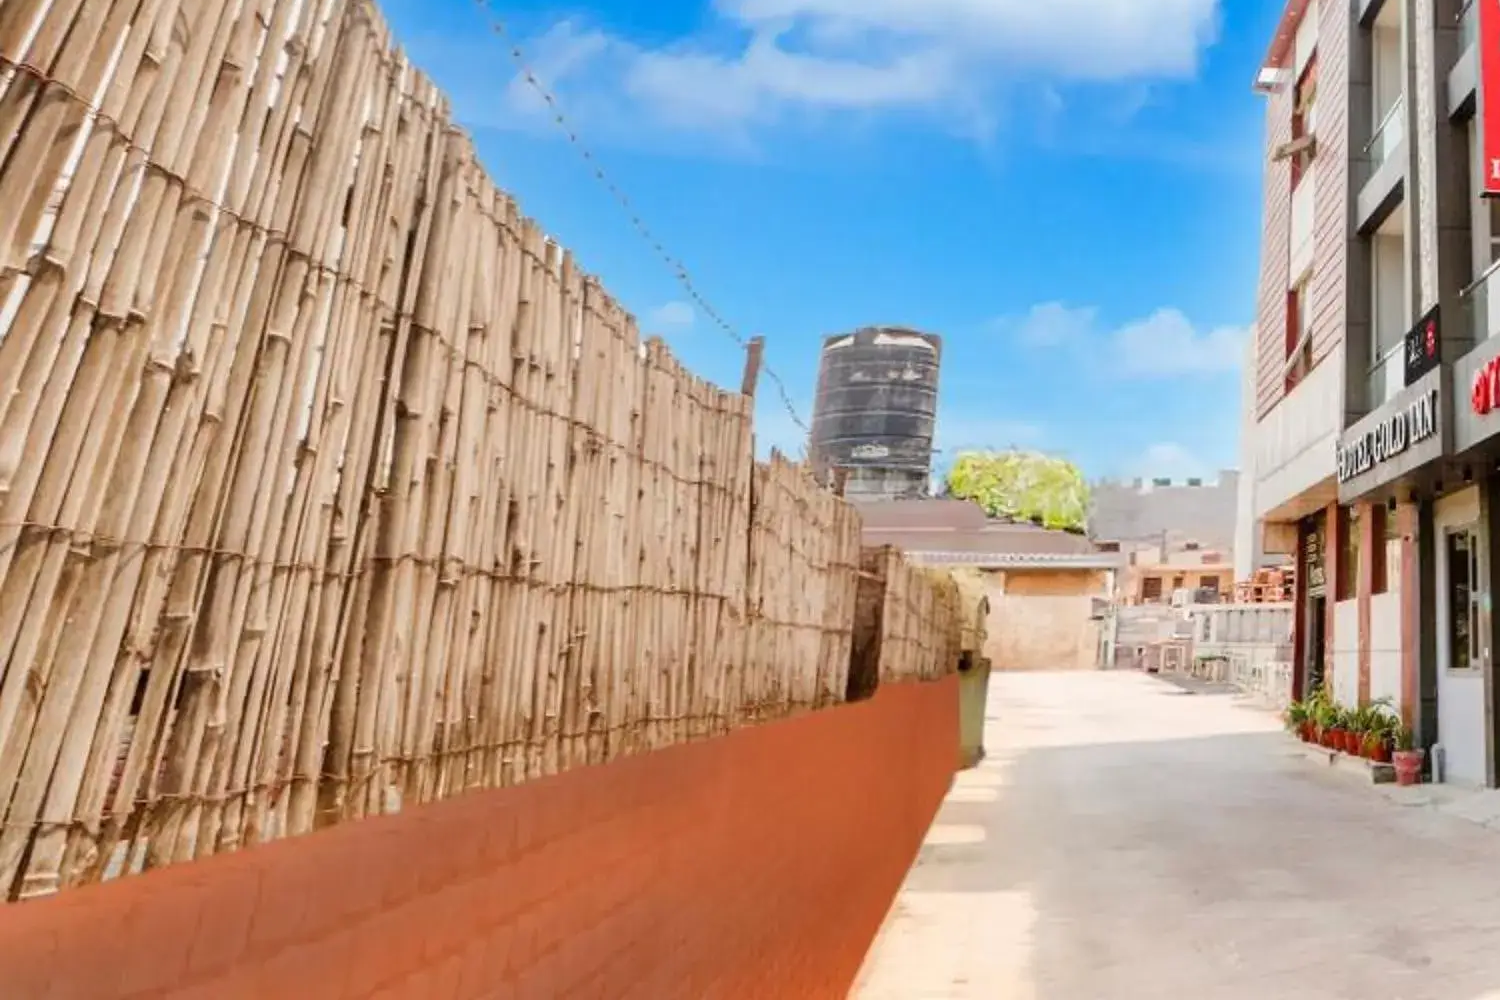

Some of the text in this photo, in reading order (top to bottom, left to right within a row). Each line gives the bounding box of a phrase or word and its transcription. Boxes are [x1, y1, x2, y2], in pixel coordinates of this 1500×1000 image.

[1336, 390, 1438, 484] HOTEL GOLD INN
